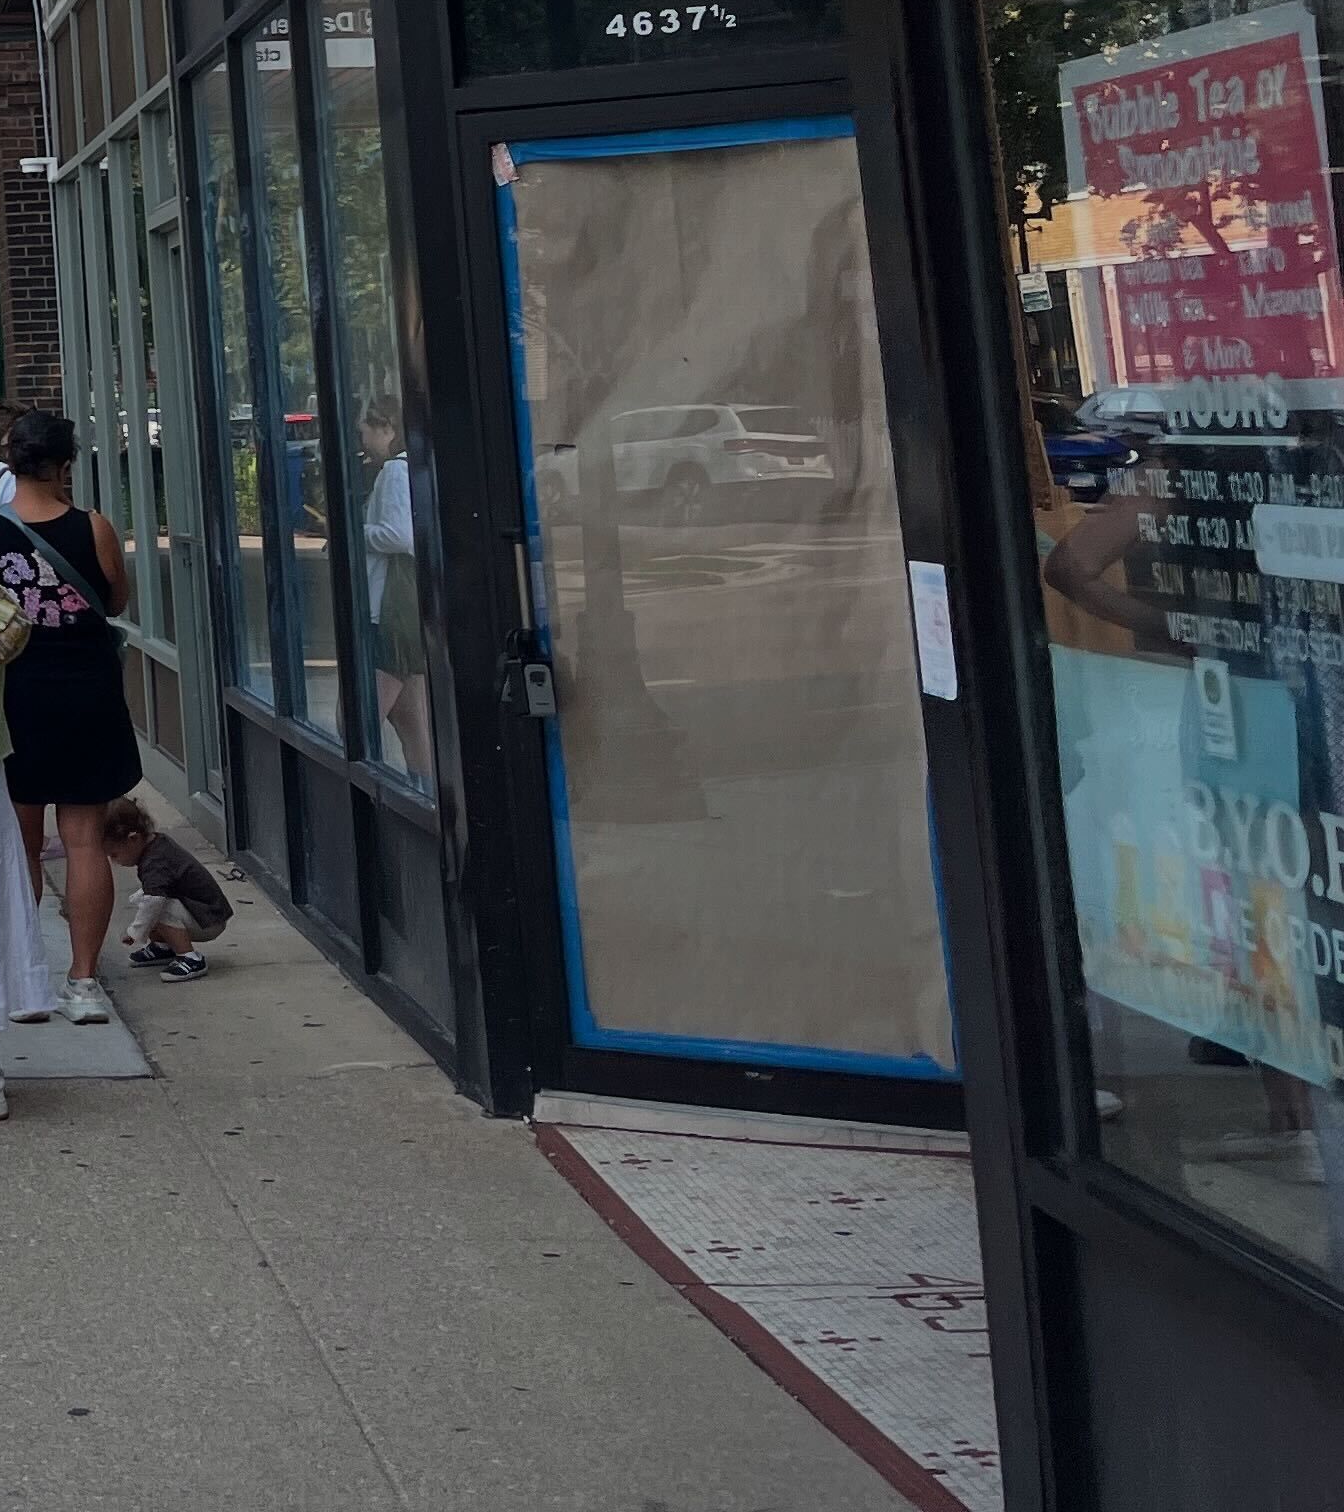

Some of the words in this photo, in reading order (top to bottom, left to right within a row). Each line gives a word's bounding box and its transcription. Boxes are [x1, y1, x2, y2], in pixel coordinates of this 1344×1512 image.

[1081, 79, 1180, 143] Bubble
[1188, 68, 1246, 122] Tea
[1256, 62, 1288, 110] or
[1116, 128, 1262, 189] Smoothie
[1163, 372, 1289, 430] HOURS
